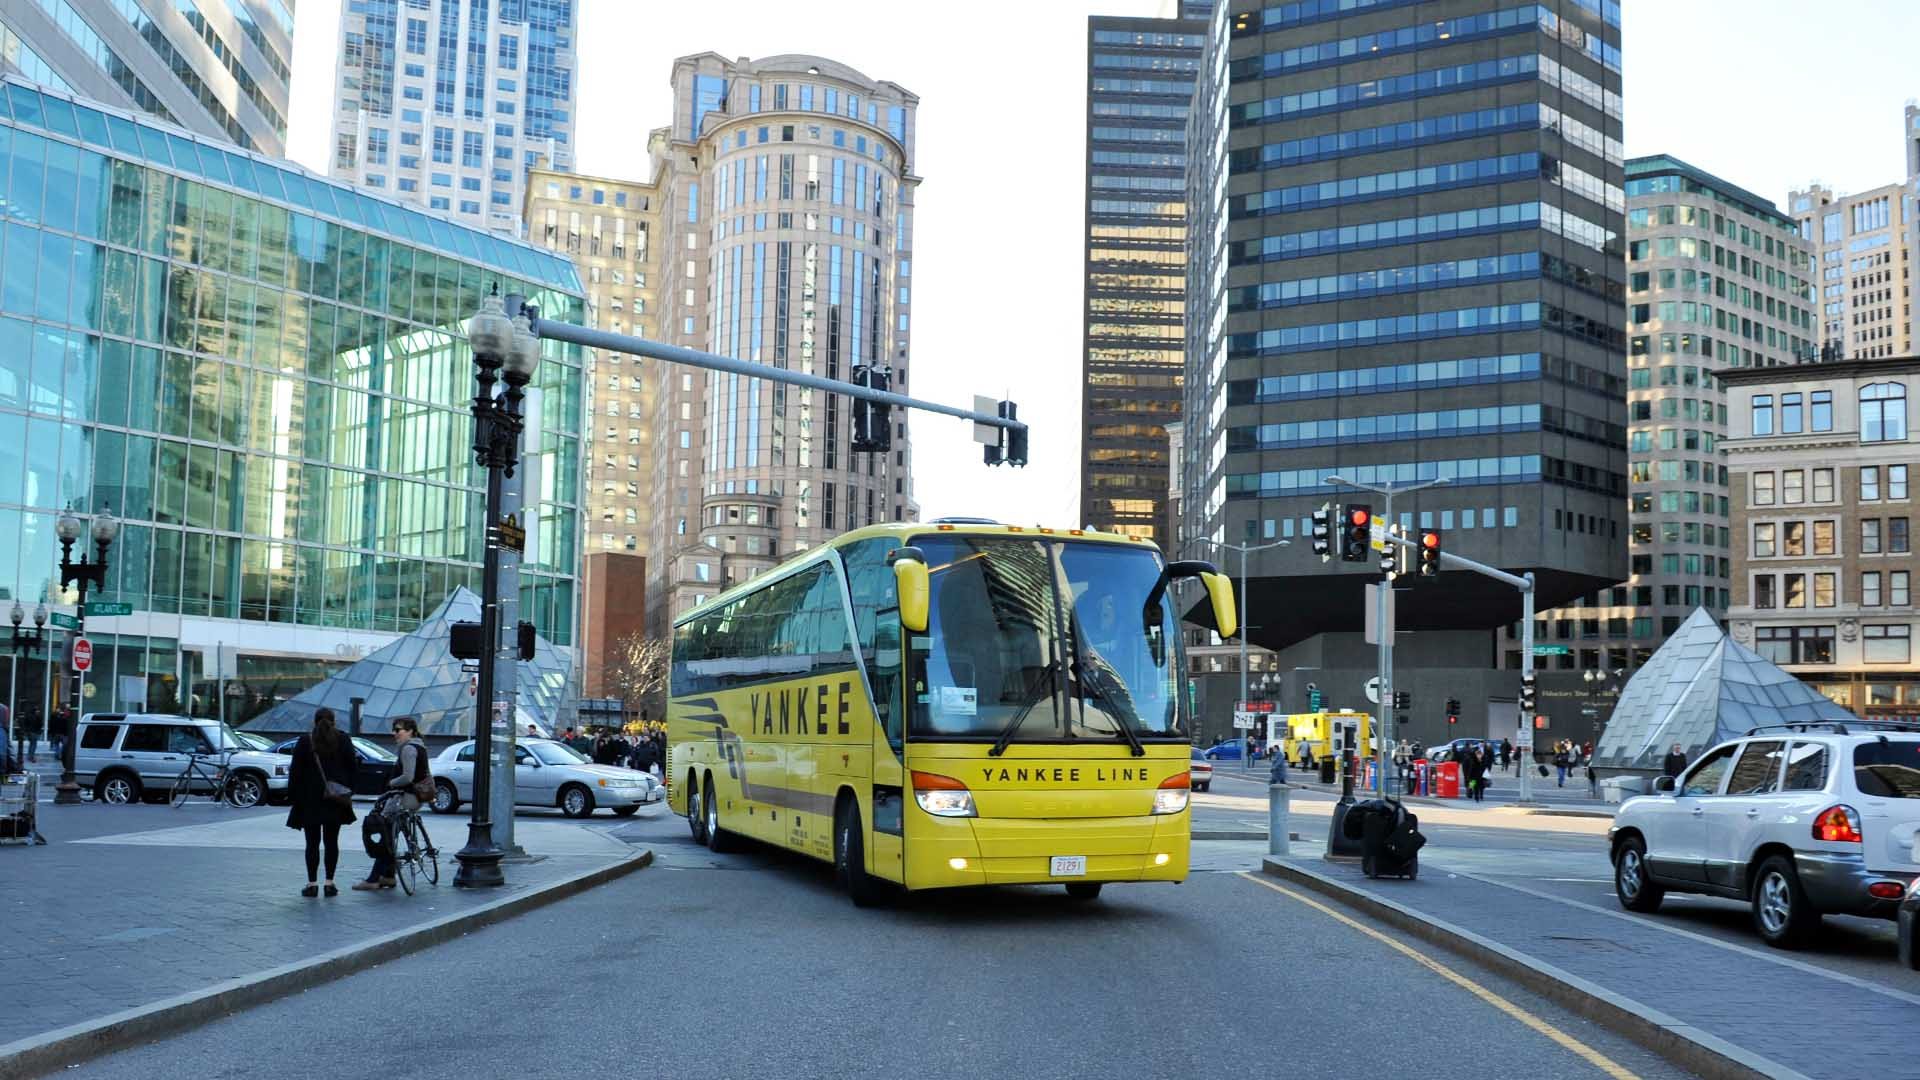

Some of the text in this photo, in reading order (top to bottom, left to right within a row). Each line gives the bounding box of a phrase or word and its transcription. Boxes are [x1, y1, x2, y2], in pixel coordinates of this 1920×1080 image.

[93, 603, 122, 613] ATLANTIC
[751, 682, 850, 735] YANKEE
[982, 768, 1149, 782] YANKEE LINE
[1056, 860, 1081, 872] 21291
